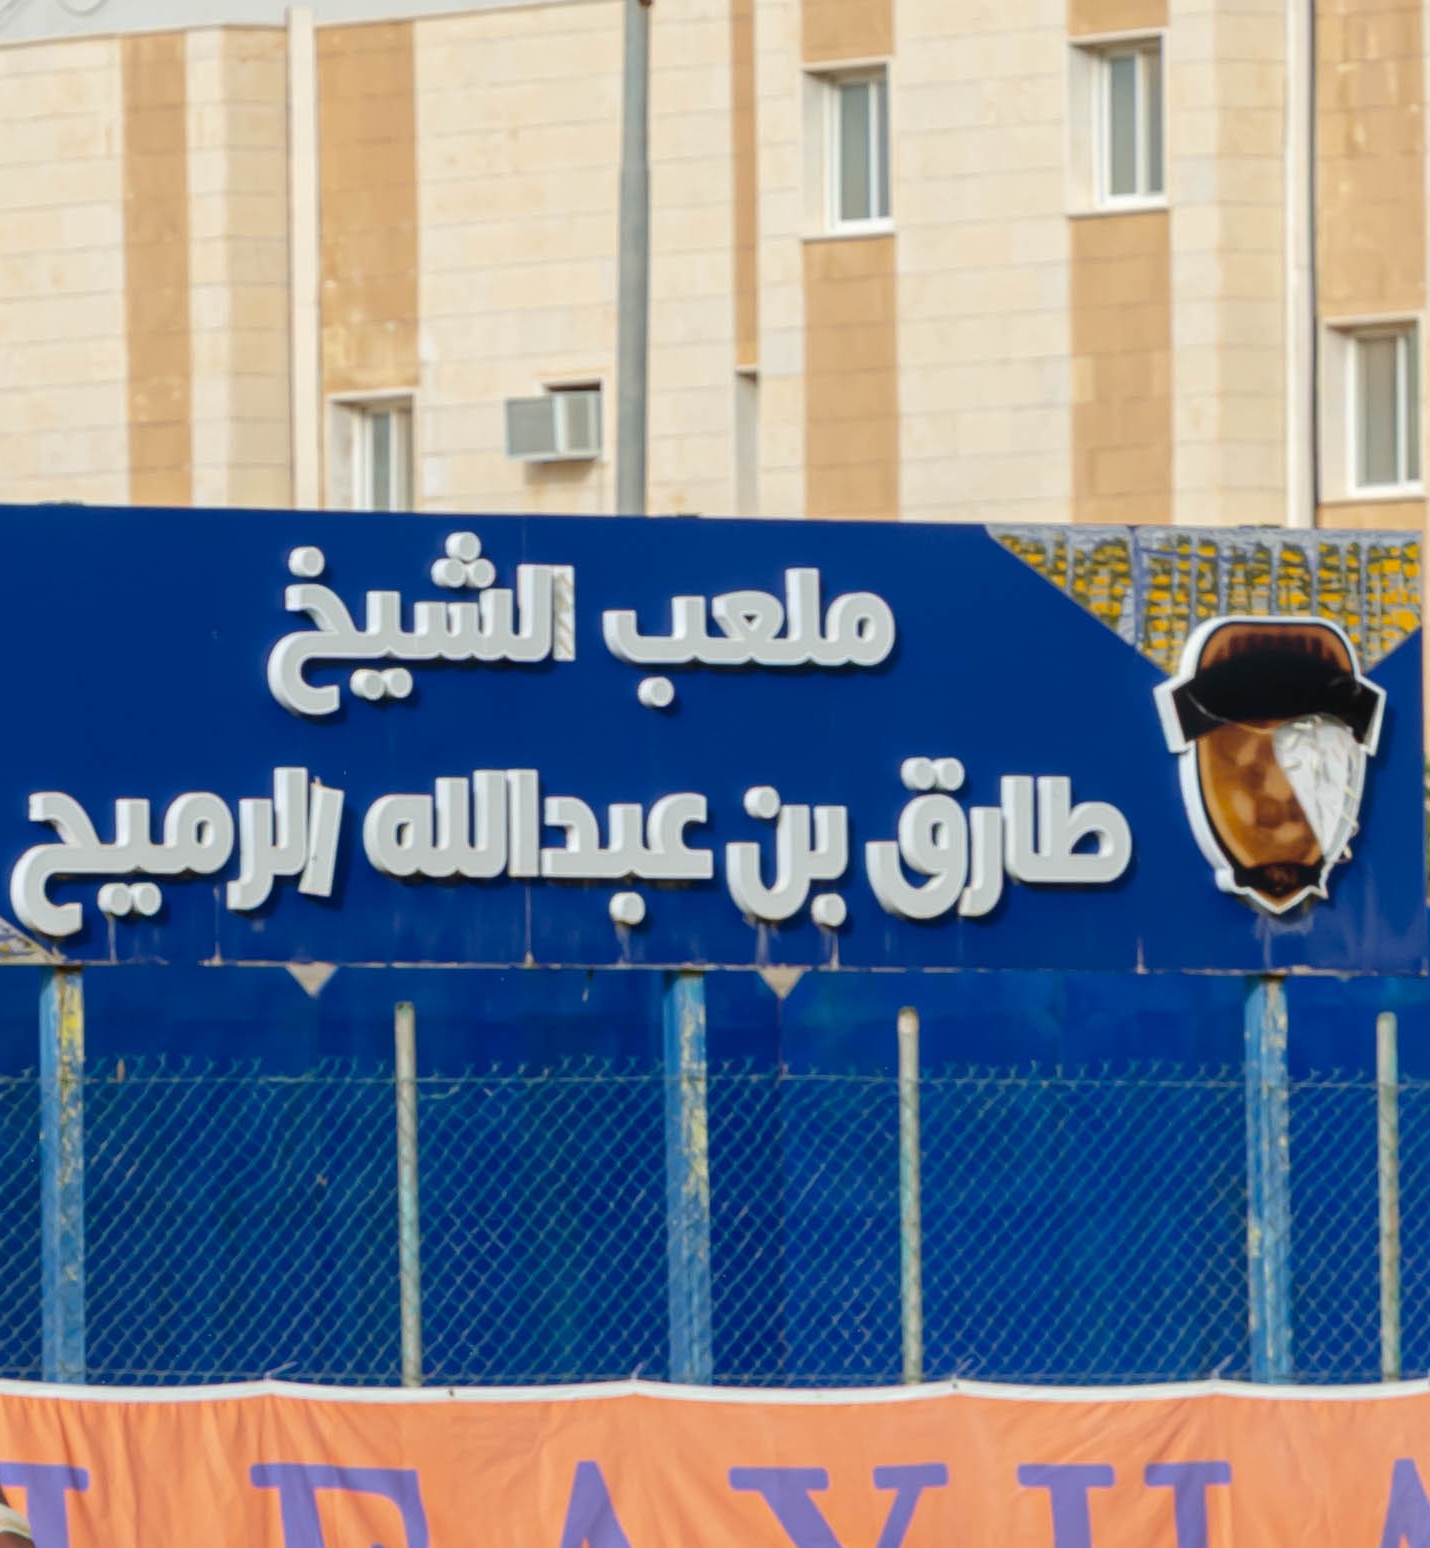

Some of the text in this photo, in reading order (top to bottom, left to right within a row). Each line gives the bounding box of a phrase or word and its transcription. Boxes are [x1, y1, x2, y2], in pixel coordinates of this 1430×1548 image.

[267, 531, 896, 716] ملعب الشيخ
[10, 766, 345, 937] الرميح
[726, 786, 848, 927] بن
[864, 757, 1133, 920] طارق
